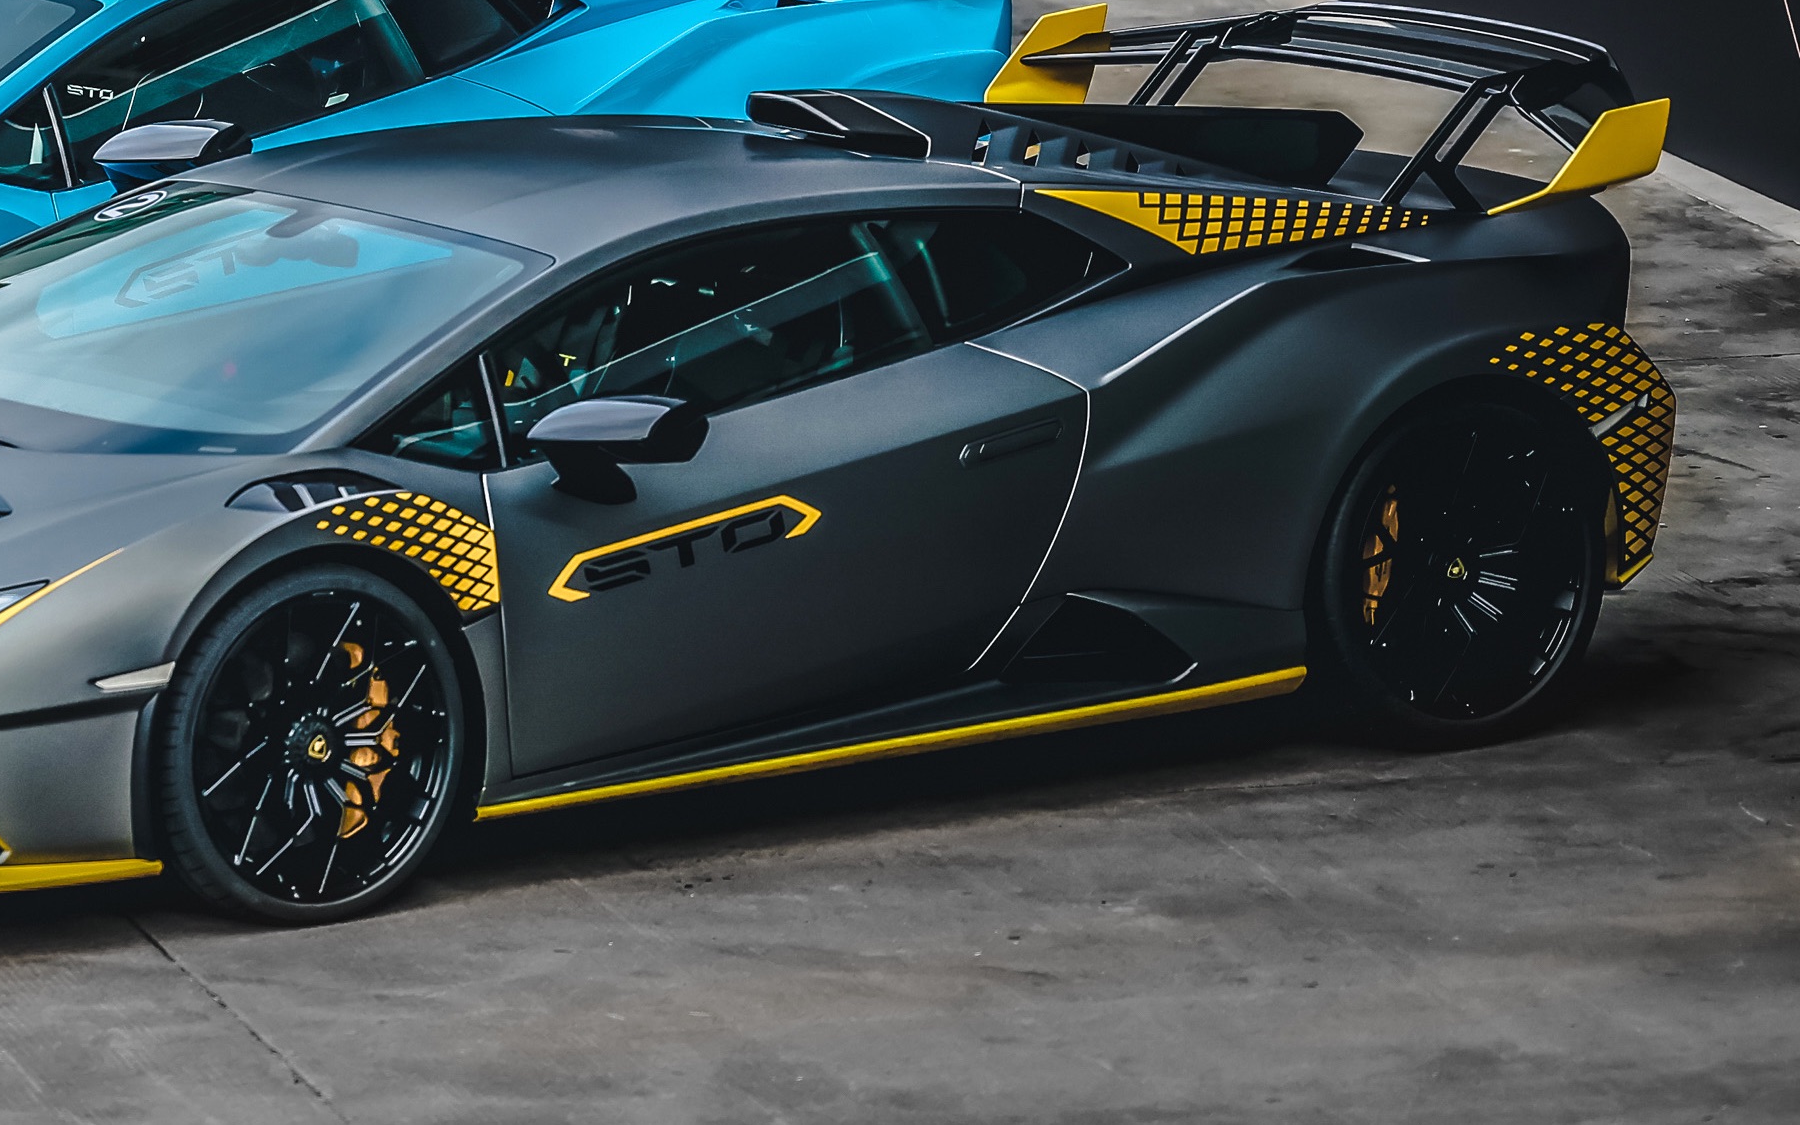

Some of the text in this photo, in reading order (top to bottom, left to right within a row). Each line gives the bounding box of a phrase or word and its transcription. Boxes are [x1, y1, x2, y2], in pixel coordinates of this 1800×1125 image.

[65, 83, 114, 100] STO
[101, 193, 160, 218] 2
[583, 509, 786, 592] STO
